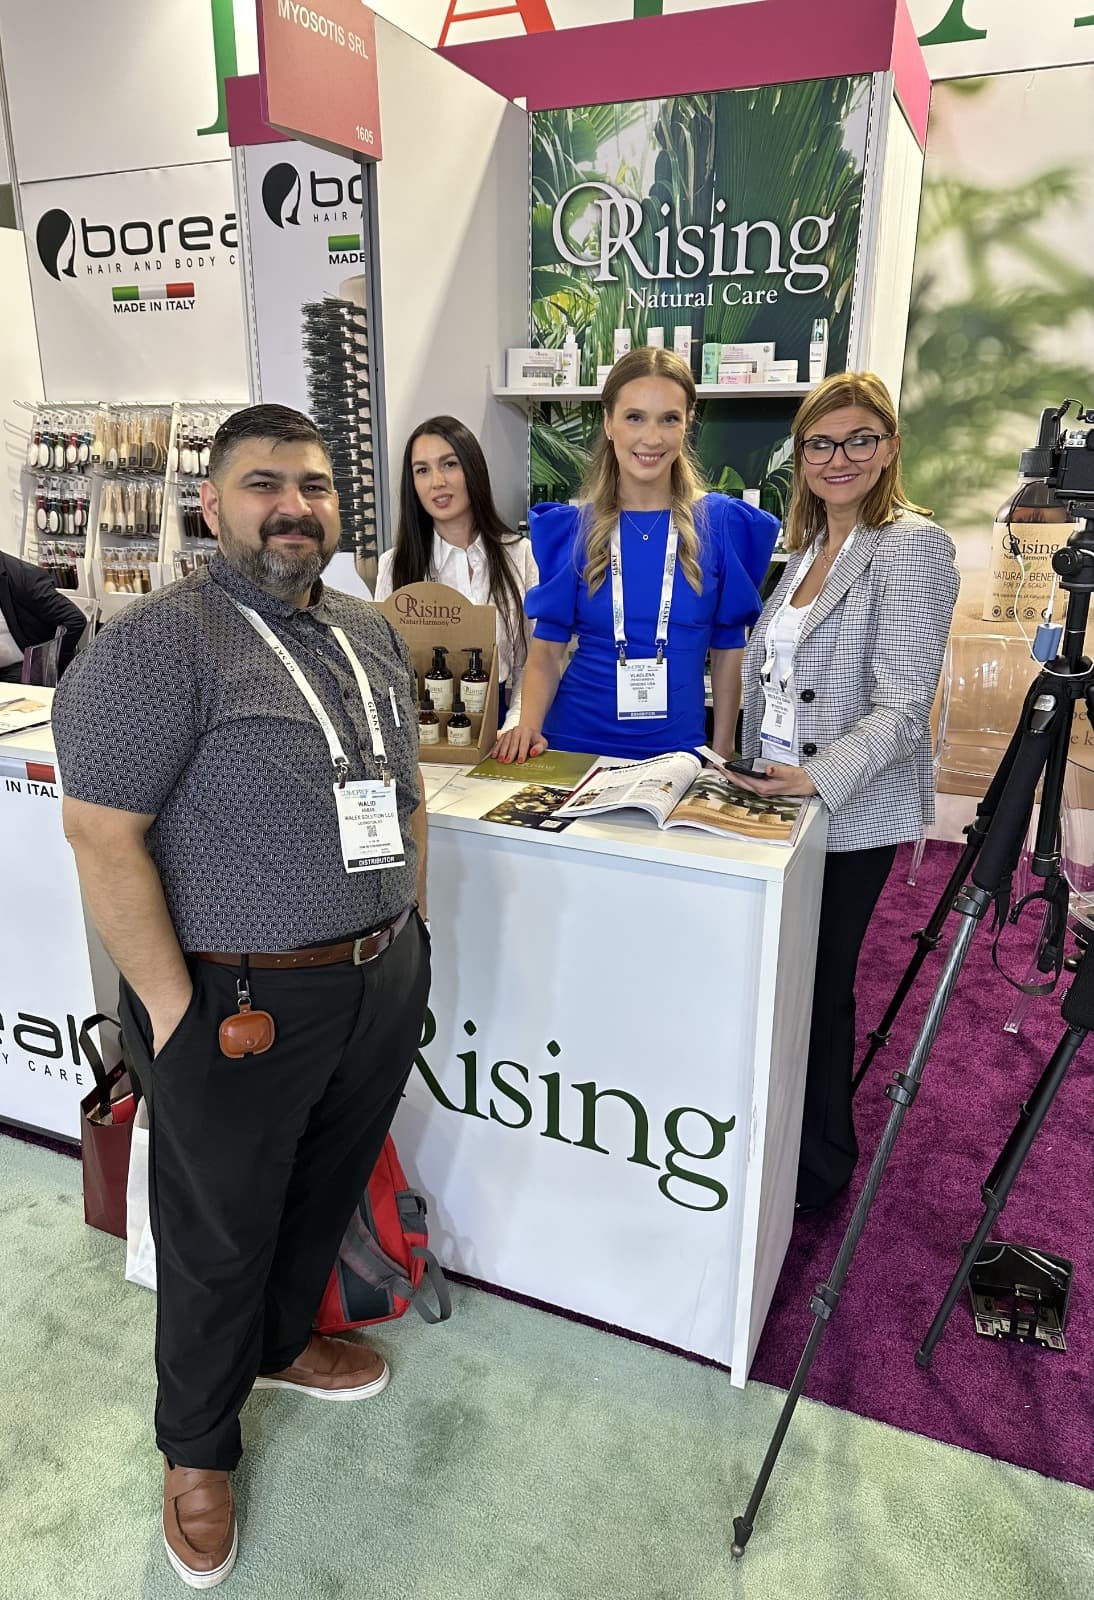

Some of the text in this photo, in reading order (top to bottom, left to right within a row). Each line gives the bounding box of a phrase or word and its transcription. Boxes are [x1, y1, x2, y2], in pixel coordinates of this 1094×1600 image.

[278, 0, 369, 60] MYOSOTIS SRL
[355, 125, 374, 145] 1605
[313, 211, 348, 222] HAIR
[87, 262, 122, 275] HAIR
[134, 260, 162, 272] AND
[175, 256, 216, 269] BODY
[328, 253, 365, 265] MADE
[627, 282, 778, 309] Natural Care
[113, 300, 196, 314] MADE IN ITALY
[6, 780, 58, 799] IN ITAL
[358, 856, 395, 866] DISTRIBUTOR
[28, 1060, 84, 1086] CARE
